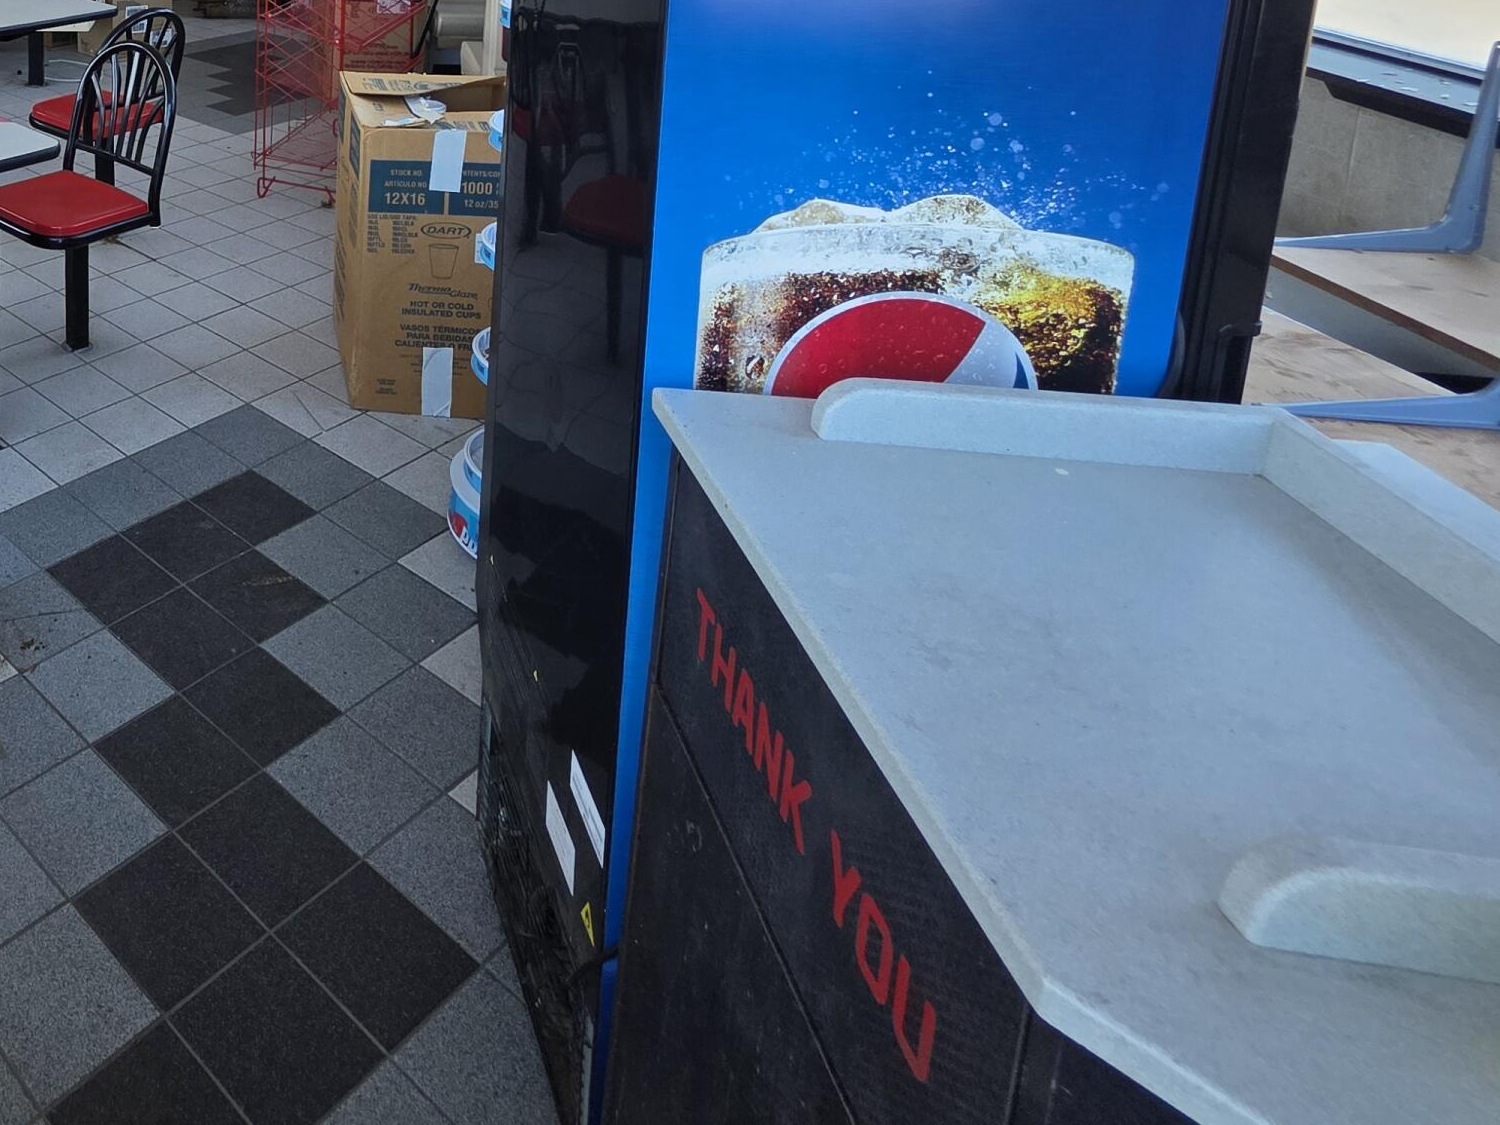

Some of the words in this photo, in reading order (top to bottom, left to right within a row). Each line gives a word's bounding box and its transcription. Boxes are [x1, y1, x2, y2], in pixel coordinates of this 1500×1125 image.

[462, 181, 493, 195] 1000
[384, 192, 426, 205] 12X16
[464, 199, 474, 208] 12
[426, 225, 464, 235] DART
[410, 300, 430, 308] HOT
[431, 301, 445, 310] OR
[447, 302, 475, 311] COLD
[401, 308, 454, 318] INSULATED
[455, 311, 482, 320] CUPS
[399, 323, 430, 332] VASOS
[406, 332, 430, 341] PARA
[696, 586, 813, 855] THANK
[830, 828, 937, 1083] YOU
